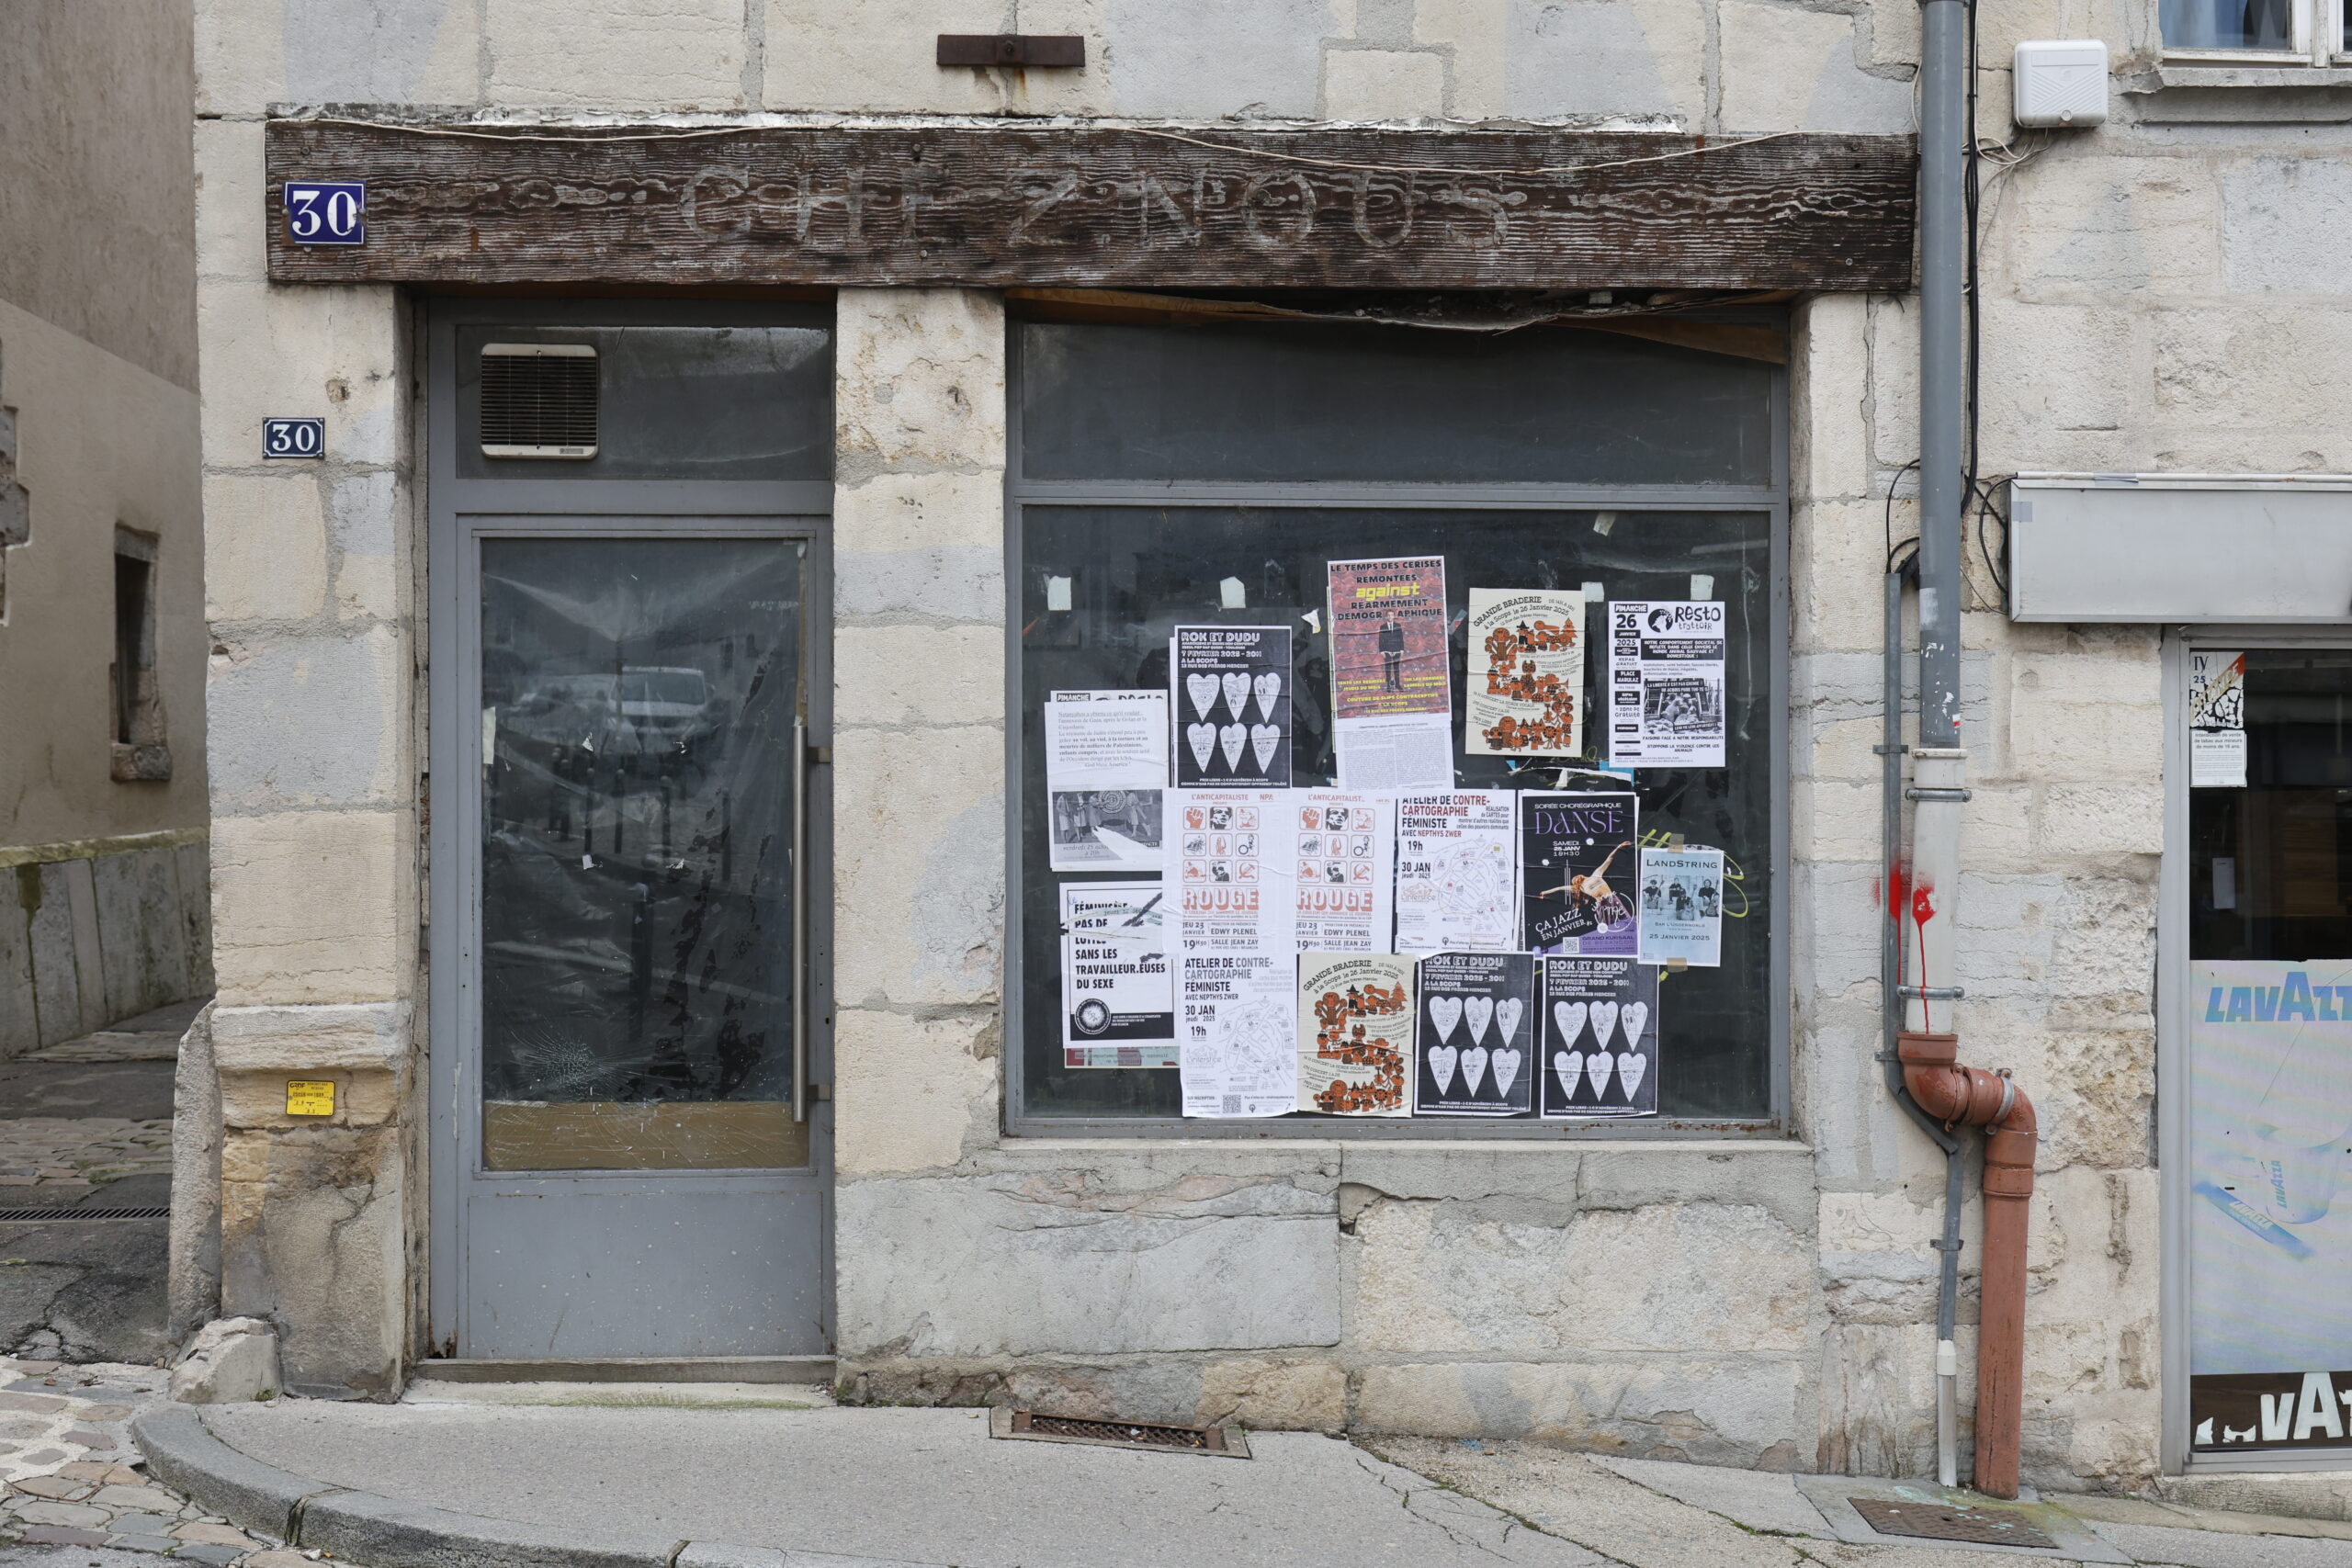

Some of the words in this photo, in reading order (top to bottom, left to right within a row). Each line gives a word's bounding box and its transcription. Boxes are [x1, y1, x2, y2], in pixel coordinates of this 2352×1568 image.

[292, 190, 358, 236] 30
[271, 423, 316, 451] 30
[1345, 563, 1377, 571] TEMPS
[1403, 560, 1442, 569] CERISES
[1356, 582, 1420, 601] against
[1397, 608, 1442, 617] APHIQUE
[1473, 604, 1502, 627] GRANDE
[1503, 597, 1542, 609] BRADERIE
[1554, 606, 1569, 616] 2025
[1616, 615, 1636, 628] 26
[1182, 632, 1207, 641] ROK
[1210, 632, 1224, 642] ET
[1227, 632, 1260, 642] DUDU
[1441, 795, 1451, 805] DE
[1453, 795, 1490, 805] CONTRE-
[1402, 806, 1468, 817] CARTOGRAPHIE
[1402, 816, 1447, 829] FÉMINISTE
[1535, 810, 1623, 835] DANSE
[1408, 840, 1422, 851] 19h
[1402, 862, 1411, 872] 30
[1414, 863, 1430, 872] JAN
[1182, 888, 1259, 910] ROUGE
[1296, 888, 1373, 911] ROUGE
[1075, 919, 1092, 929] PAS
[1535, 920, 1553, 935] ÇA
[1553, 908, 1581, 929] JAZZ
[1542, 931, 1553, 942] EN
[1553, 919, 1586, 938] JANVIER
[1076, 949, 1099, 960] SANS
[1102, 949, 1117, 959] LES
[1185, 958, 1220, 968] ATELIER
[1223, 958, 1234, 967] DE
[1236, 957, 1273, 967] CONTRE-
[1453, 957, 1467, 965] ET
[1470, 957, 1504, 966] DUDU
[1549, 961, 1576, 970] ROK
[1577, 961, 1592, 970] ET
[1594, 961, 1628, 971] DUDU
[1076, 963, 1165, 975] TRAVAILLEUR.EUSES
[1185, 969, 1251, 980] CARTOGRAPHIE
[1383, 970, 1398, 979] 2025
[1303, 968, 1332, 991] GRANDE
[1333, 960, 1372, 972] BRADERIE
[1077, 979, 1090, 989] DU
[1093, 979, 1114, 988] SEXE
[1185, 979, 1230, 992] FÉMINISTE
[1185, 1005, 1195, 1015] 30
[1198, 1005, 1216, 1015] JAN
[1191, 1026, 1206, 1036] 19h
